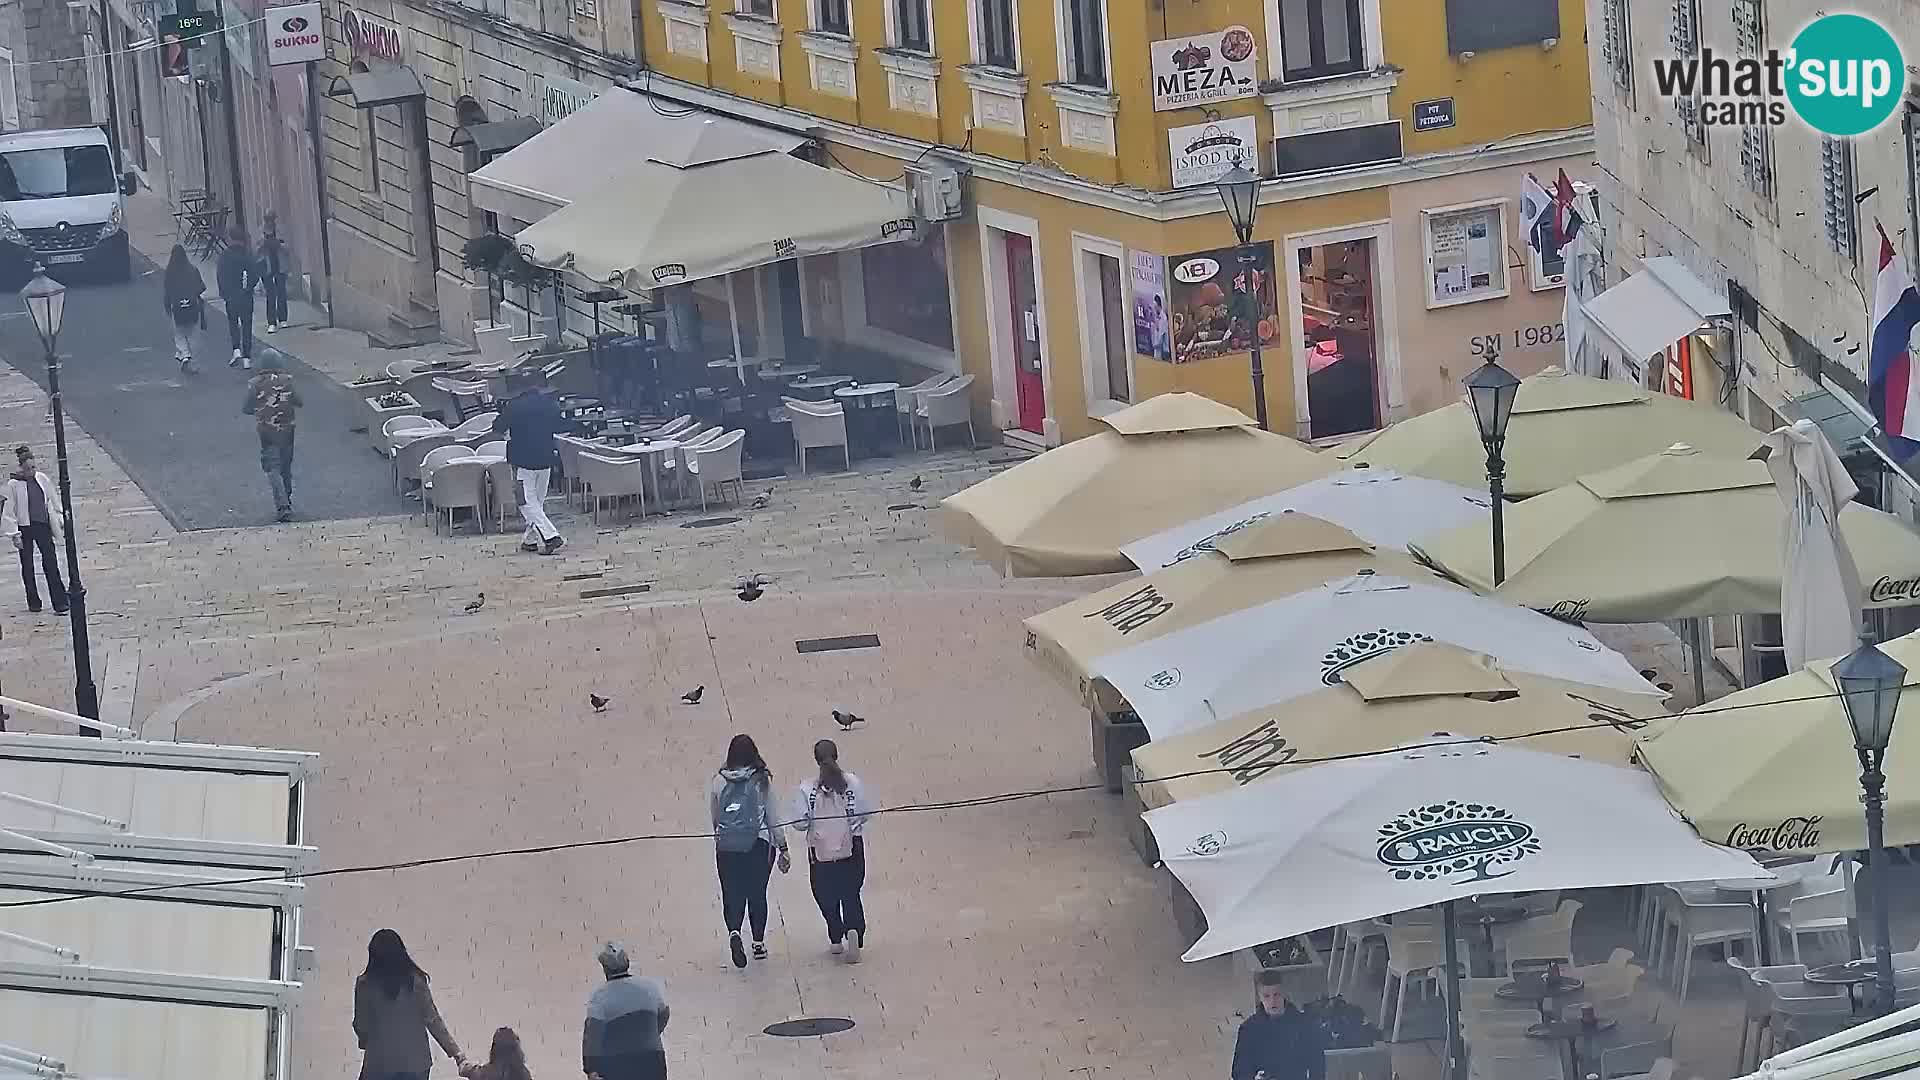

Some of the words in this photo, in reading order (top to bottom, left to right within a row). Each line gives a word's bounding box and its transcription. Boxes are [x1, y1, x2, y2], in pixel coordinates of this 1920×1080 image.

[274, 34, 320, 49] SUKNO
[361, 19, 400, 57] SUKNO
[1157, 66, 1236, 96] MEZA
[1166, 92, 1199, 104] PIZZERIA
[1207, 89, 1228, 98] GRILL
[1176, 151, 1221, 170] ISPOD
[1470, 333, 1501, 356] SM
[1512, 323, 1566, 348] 1982
[1417, 825, 1516, 855] RAUCH
[1726, 816, 1824, 851] Coca-Cola
